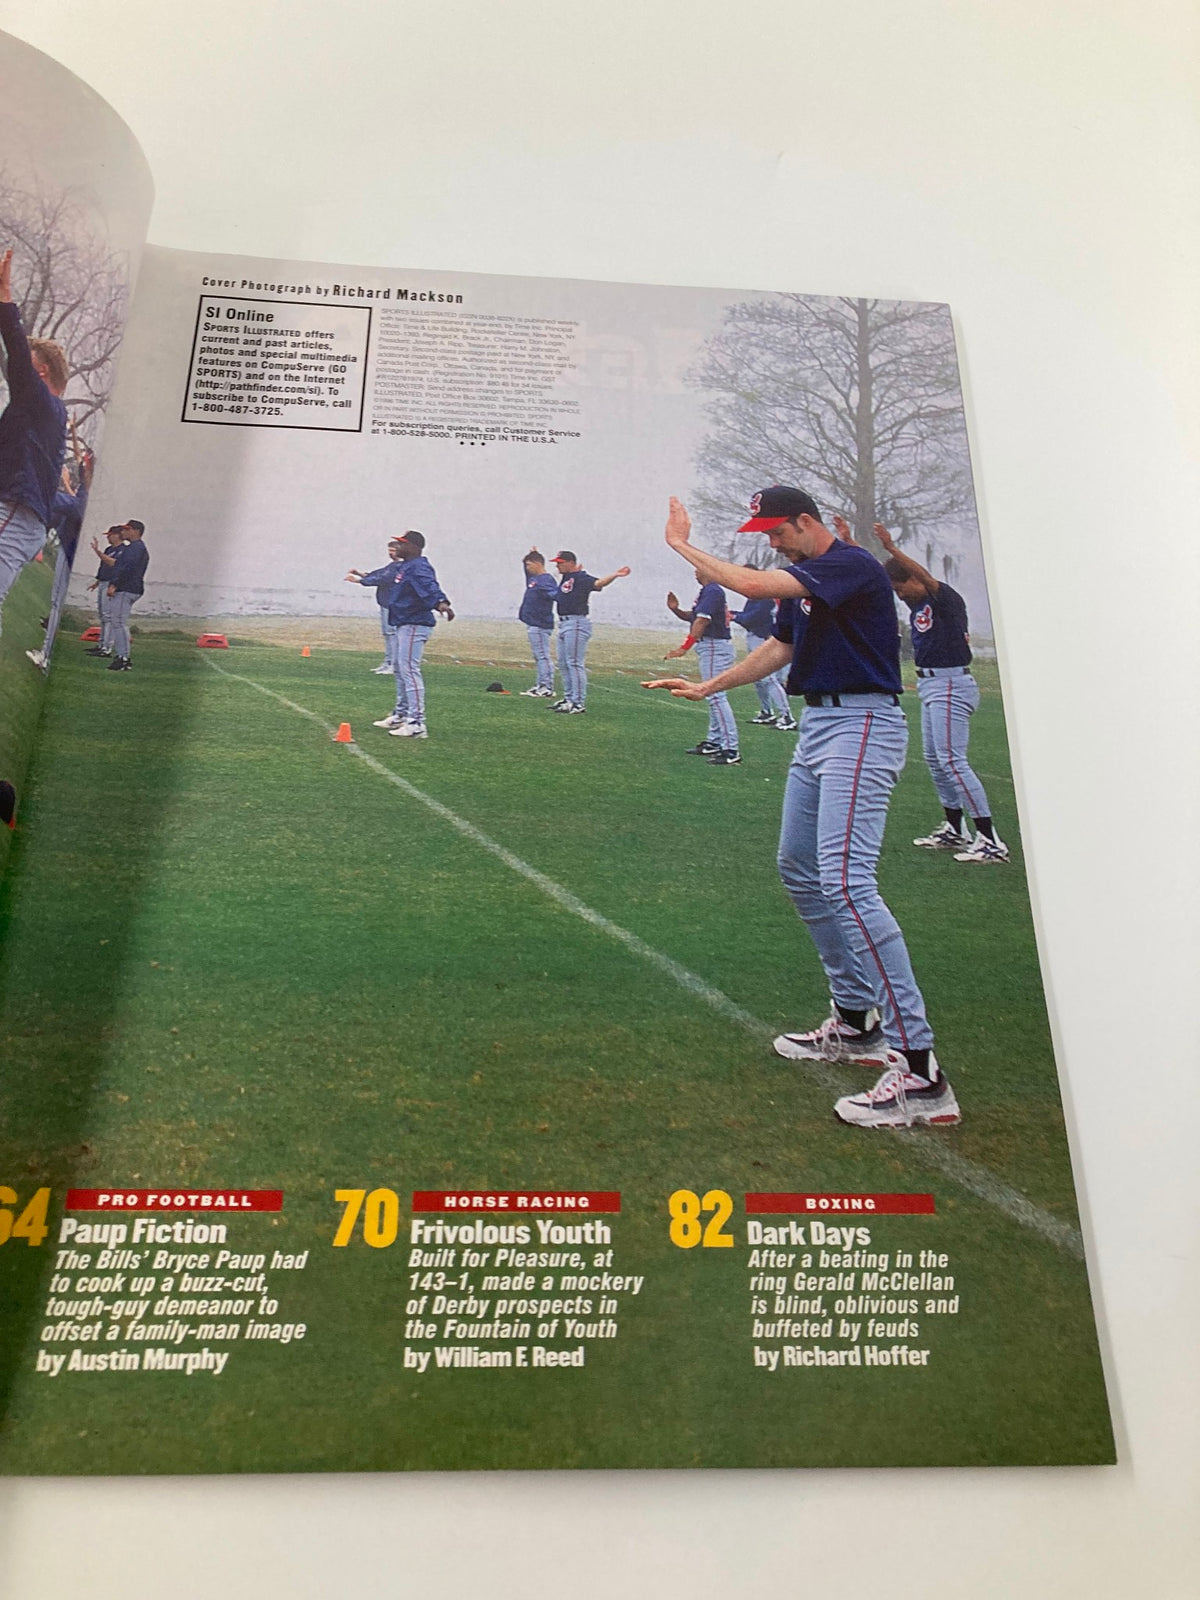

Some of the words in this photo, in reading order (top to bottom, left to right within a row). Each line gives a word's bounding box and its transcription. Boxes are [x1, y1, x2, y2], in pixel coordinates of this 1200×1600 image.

[202, 277, 236, 288] Cover
[241, 280, 311, 295] Photograph
[316, 287, 328, 296] by
[333, 285, 390, 299] Richard
[397, 289, 463, 303] Mackson
[206, 307, 220, 318] SI
[226, 309, 274, 322] Online
[201, 336, 239, 344] current
[265, 340, 287, 348] past
[290, 341, 333, 350] articles,
[305, 330, 335, 339] offers
[200, 346, 234, 355] photos
[238, 348, 257, 357] and
[260, 350, 297, 360] special
[301, 353, 357, 362] multimedia
[197, 368, 241, 380] SPORTS)
[284, 374, 300, 382] the
[304, 374, 345, 384] Internet
[198, 357, 241, 368] features
[261, 361, 324, 372] CompuServe
[328, 364, 347, 374] (GO
[193, 392, 244, 402] subscribe
[261, 395, 329, 408] CompuServe,
[328, 386, 338, 395] To
[192, 403, 283, 416] 1-800-487-3725.
[389, 422, 444, 431] subscription
[503, 427, 546, 435] Customer
[455, 432, 496, 440] PRINTED
[98, 1194, 138, 1206] PRO
[147, 1194, 252, 1206] FOOTBALL
[444, 1196, 509, 1208] HORSE
[517, 1196, 590, 1208] RACING
[806, 1198, 876, 1210] BOXING
[332, 1188, 399, 1248] 70
[669, 1189, 734, 1248] 82
[59, 1218, 127, 1249] Paup
[132, 1219, 226, 1243] Fiction
[410, 1219, 530, 1245] Frivolous
[536, 1220, 611, 1245] Youth
[747, 1221, 806, 1245] Dark
[810, 1221, 871, 1250] Days
[55, 1250, 91, 1269] The
[153, 1251, 209, 1272] Bryce
[215, 1252, 266, 1272] Paup
[270, 1250, 309, 1269] had
[408, 1249, 455, 1267] Built
[461, 1249, 489, 1267] for
[494, 1250, 586, 1270] Pleasure,
[593, 1250, 613, 1267] at
[748, 1250, 795, 1268] After
[801, 1255, 812, 1268] a
[819, 1250, 889, 1270] beating
[896, 1250, 912, 1268] in
[919, 1250, 948, 1268] the
[50, 1274, 70, 1293] to
[76, 1274, 126, 1293] cook
[130, 1276, 156, 1296] up
[161, 1277, 172, 1292] a
[179, 1273, 269, 1295] buzz-cut,
[482, 1272, 535, 1290] made
[542, 1277, 554, 1290] a
[560, 1273, 644, 1295] mockery
[750, 1273, 786, 1294] ring
[794, 1273, 855, 1291] Gerald
[862, 1273, 954, 1291] McClellan
[46, 1297, 150, 1320] tough-guy
[154, 1296, 254, 1316] demeanor
[259, 1296, 278, 1315] to
[406, 1296, 427, 1315] of
[432, 1296, 490, 1318] Derby
[494, 1297, 593, 1318] prospects
[599, 1296, 618, 1314] in
[751, 1296, 768, 1314] is
[775, 1296, 827, 1318] blind,
[834, 1296, 919, 1314] oblivious
[925, 1296, 959, 1313] and
[41, 1321, 103, 1341] offset
[106, 1325, 119, 1340] a
[125, 1320, 240, 1344] family-man
[244, 1320, 306, 1343] image
[405, 1320, 436, 1339] the
[444, 1320, 531, 1338] Fountain
[537, 1320, 558, 1338] of
[565, 1319, 618, 1338] Youth
[753, 1319, 832, 1338] buffeted
[840, 1319, 861, 1341] by
[868, 1319, 919, 1337] feuds
[36, 1350, 65, 1377] by
[67, 1349, 139, 1371] Austin
[143, 1349, 229, 1375] Murphy
[404, 1347, 431, 1373] by
[434, 1347, 511, 1367] William
[532, 1346, 584, 1367] Reed
[754, 1346, 779, 1371] by
[784, 1346, 861, 1366] Richard
[865, 1346, 930, 1366] Hoffer
